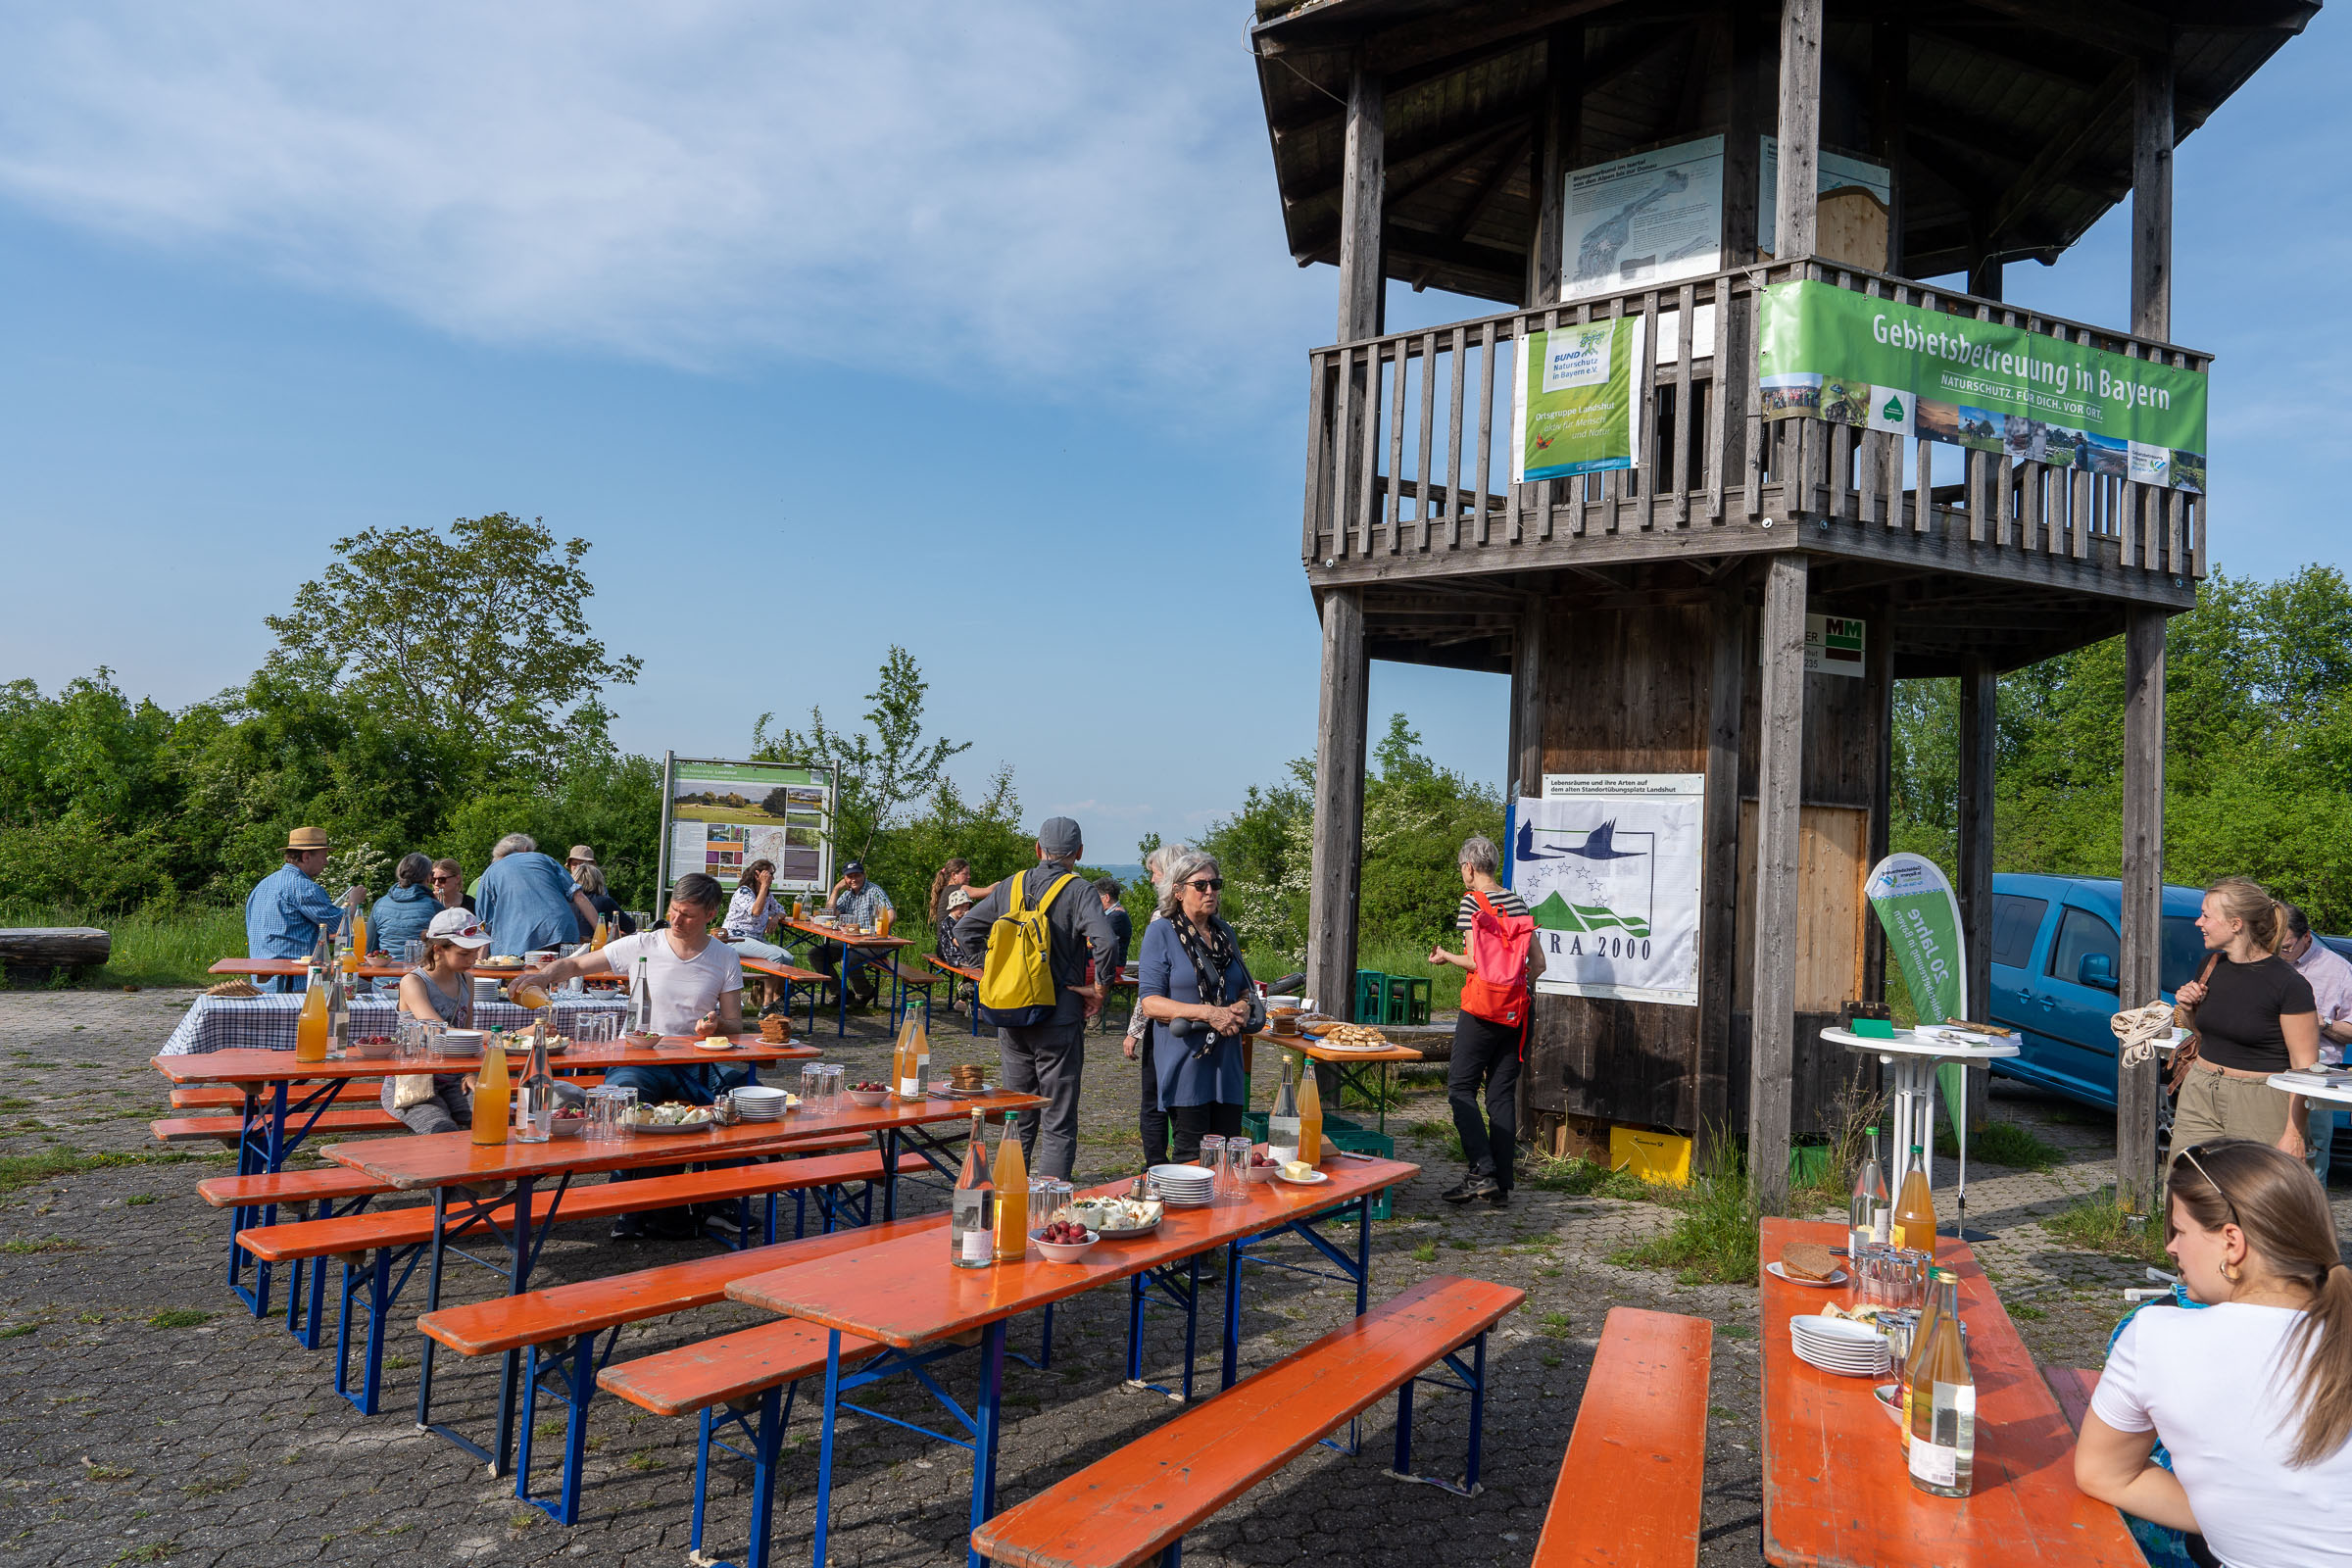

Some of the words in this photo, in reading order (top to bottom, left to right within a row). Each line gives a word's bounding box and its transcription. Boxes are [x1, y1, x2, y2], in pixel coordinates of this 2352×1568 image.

[1597, 173, 1615, 182] Alpen
[1637, 163, 1658, 172] Donau
[1553, 358, 1598, 371] Naturschutz
[1554, 351, 1581, 363] BUND
[1873, 314, 2069, 395] Gebietsbetreuung
[2076, 362, 2094, 393] in
[2099, 368, 2170, 410] Bayern
[1552, 371, 1560, 380] in
[1560, 368, 1586, 379] Bayern
[1941, 374, 2014, 400] NATURSCHUTZ.
[2016, 390, 2034, 403] FÜR
[2036, 396, 2062, 410] DICH.
[2064, 402, 2084, 415] VOR
[2085, 406, 2104, 419] ORT.
[1536, 407, 1577, 421] Ortsgruppe
[1579, 401, 1615, 414] Landshut
[1544, 422, 1562, 432] aktiv
[1563, 421, 1574, 431] für
[1576, 416, 1606, 427] Mensch
[1589, 428, 1610, 437] Natur
[1597, 935, 1651, 960] 2000
